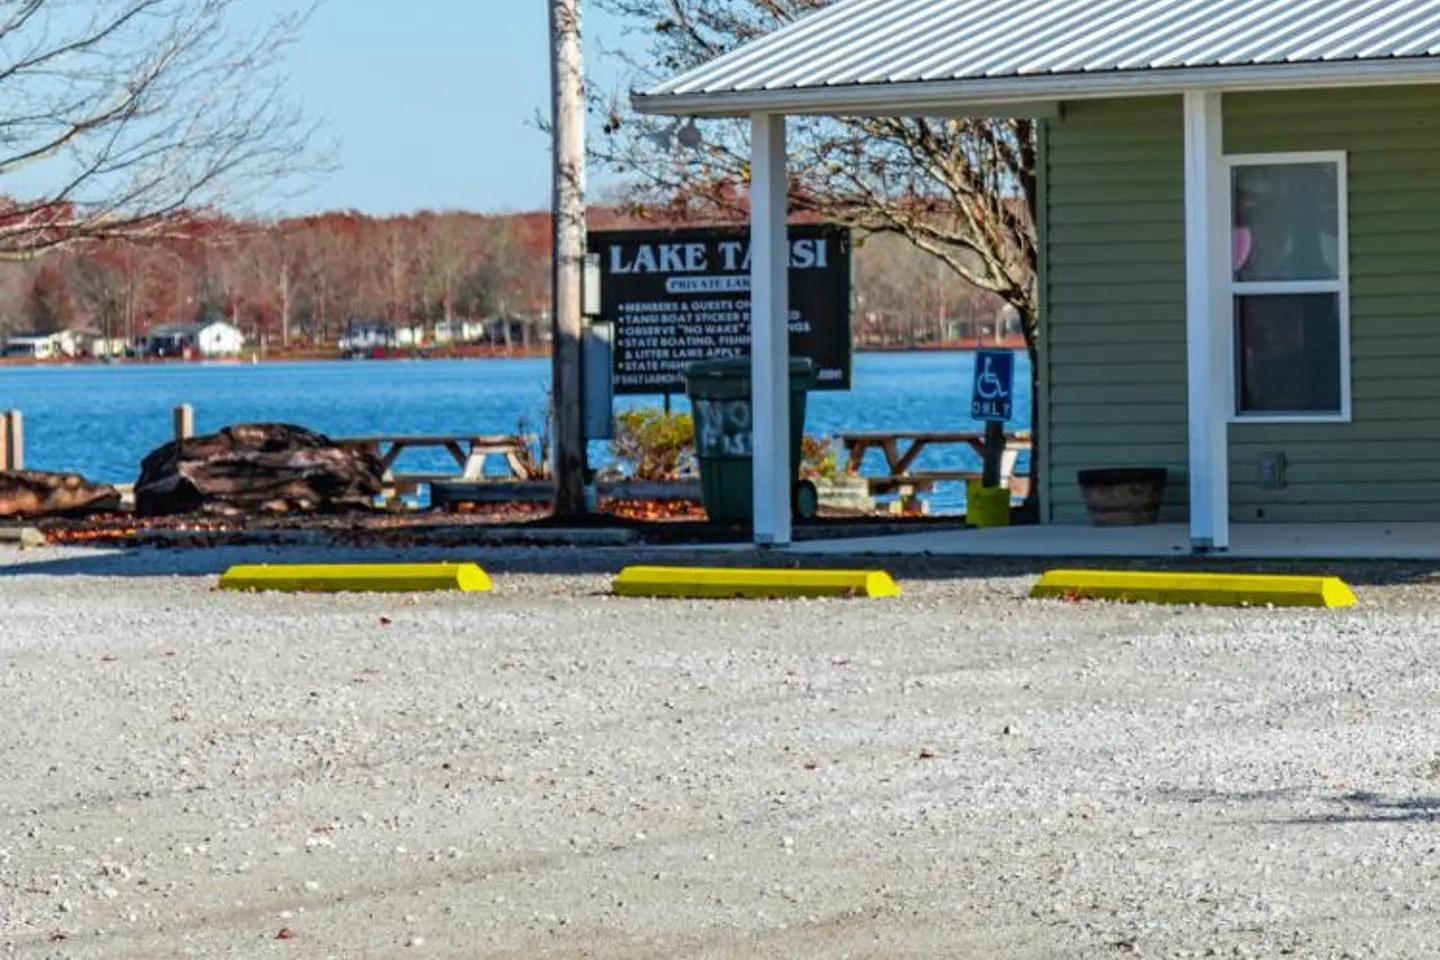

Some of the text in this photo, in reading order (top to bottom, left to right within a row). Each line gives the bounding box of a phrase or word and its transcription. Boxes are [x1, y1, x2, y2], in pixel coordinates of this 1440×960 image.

[609, 239, 827, 274] LAKE TSI
[670, 279, 751, 290] PRIVATE LAK
[691, 300, 733, 311] GUESTS
[662, 313, 692, 324] BOAT
[694, 311, 740, 322] STICKER
[625, 325, 676, 336] OBSERVE
[625, 337, 658, 347] STATE
[625, 360, 658, 371] STATE
[972, 400, 1010, 416] ONLY
[701, 427, 752, 456] FIS
